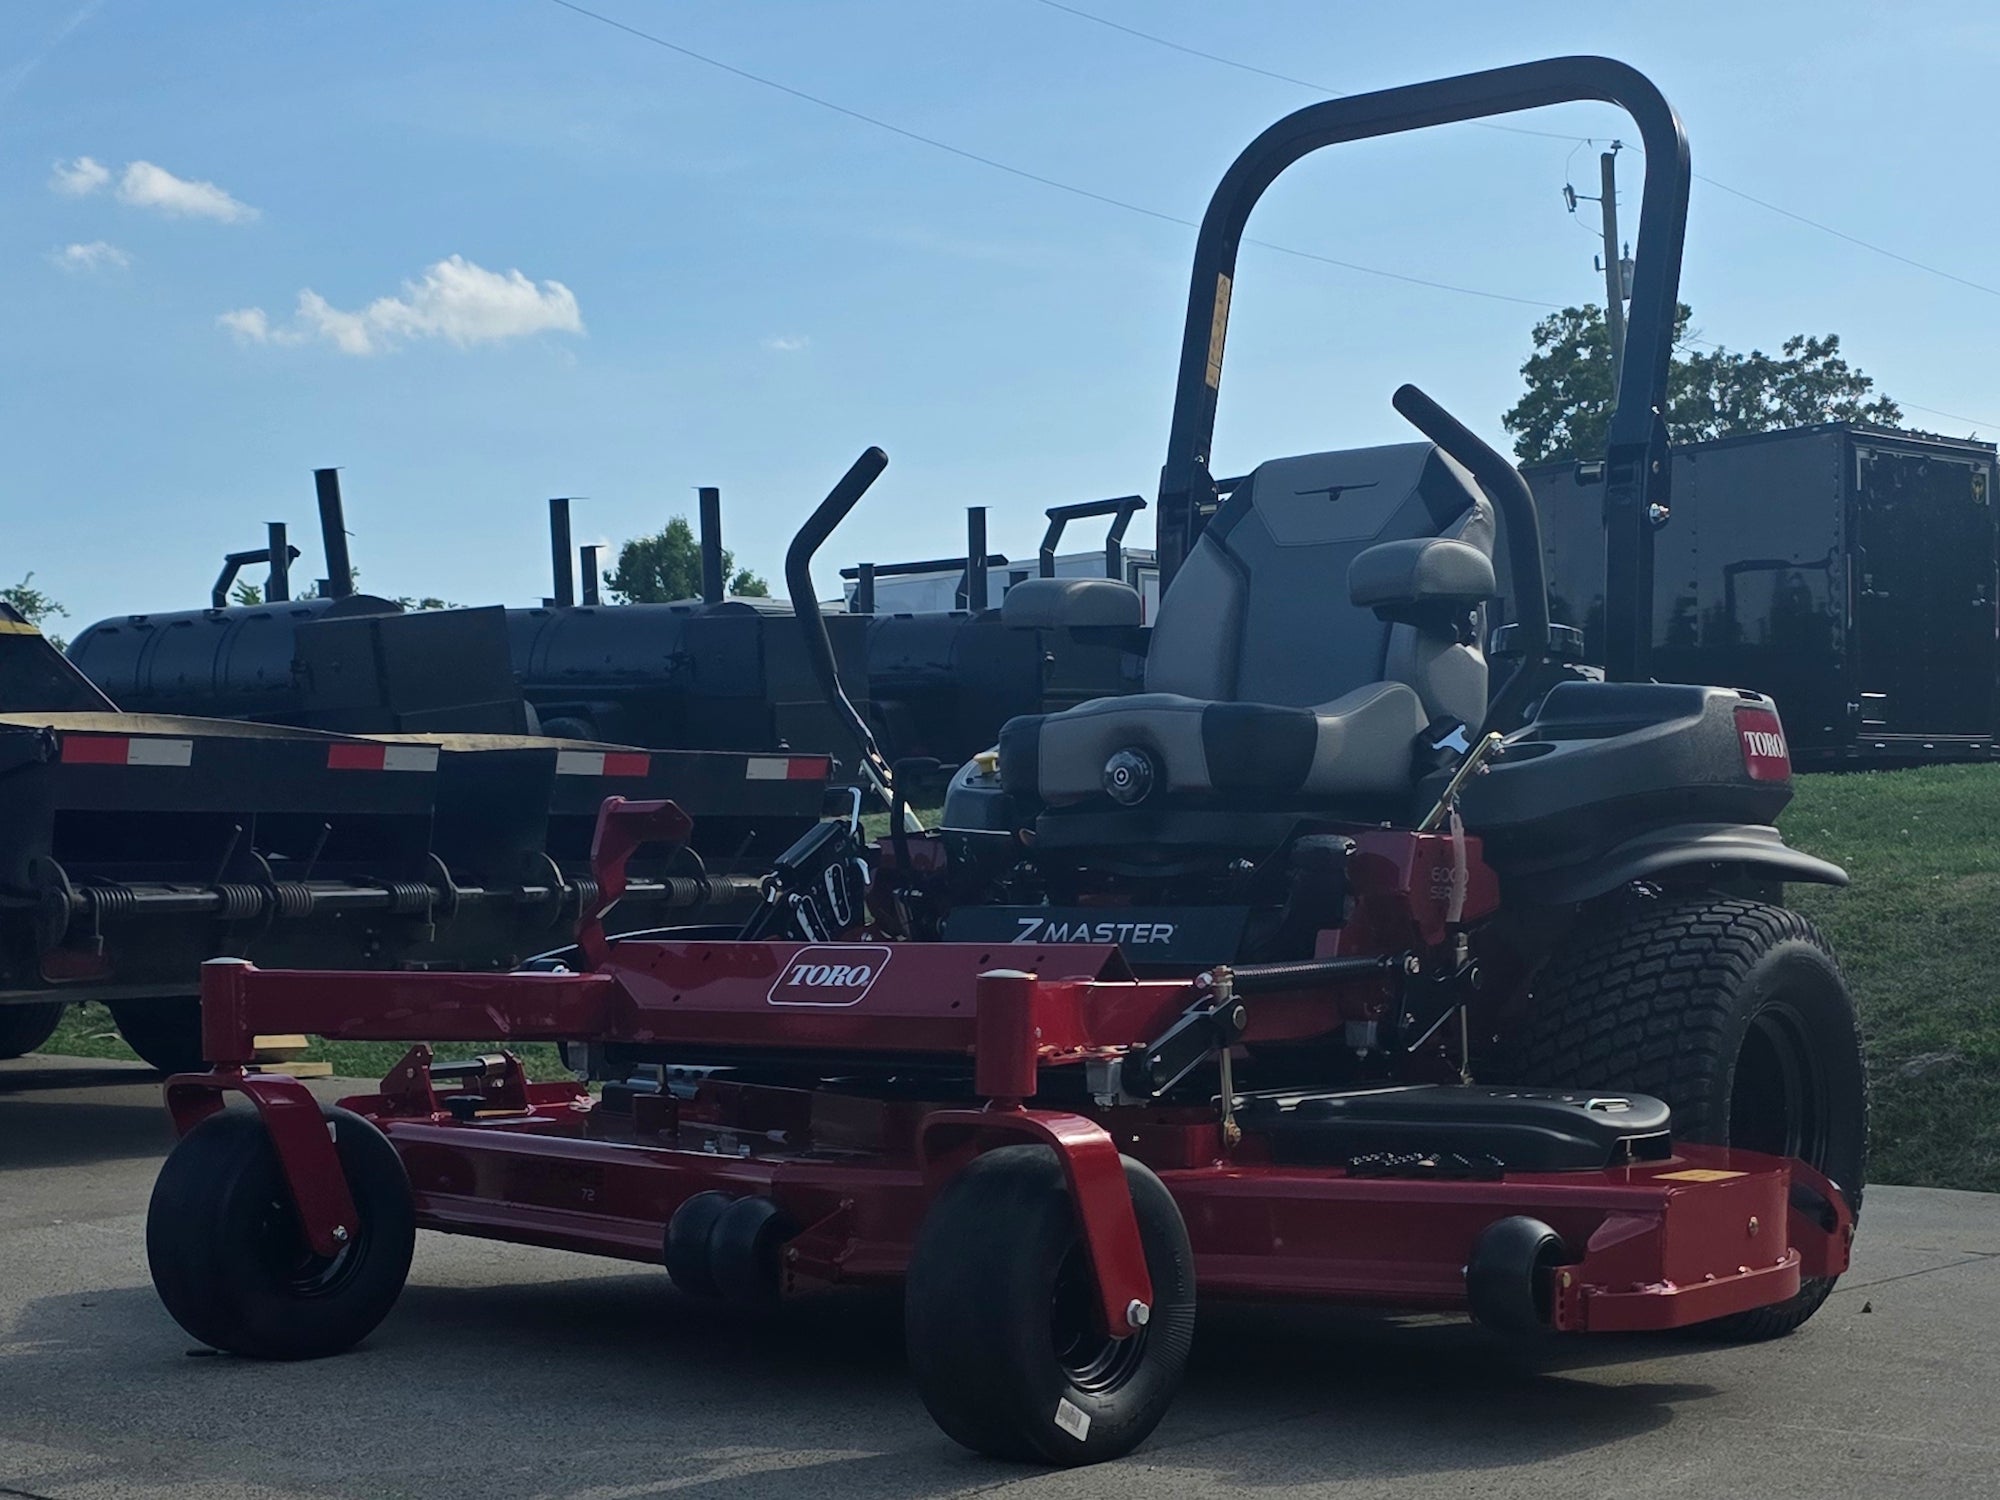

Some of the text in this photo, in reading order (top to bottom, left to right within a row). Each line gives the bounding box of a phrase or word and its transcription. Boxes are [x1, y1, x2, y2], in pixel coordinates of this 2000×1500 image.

[1743, 731, 1785, 758] TORO
[787, 965, 872, 987] TORO
[581, 1188, 595, 1201] 72
